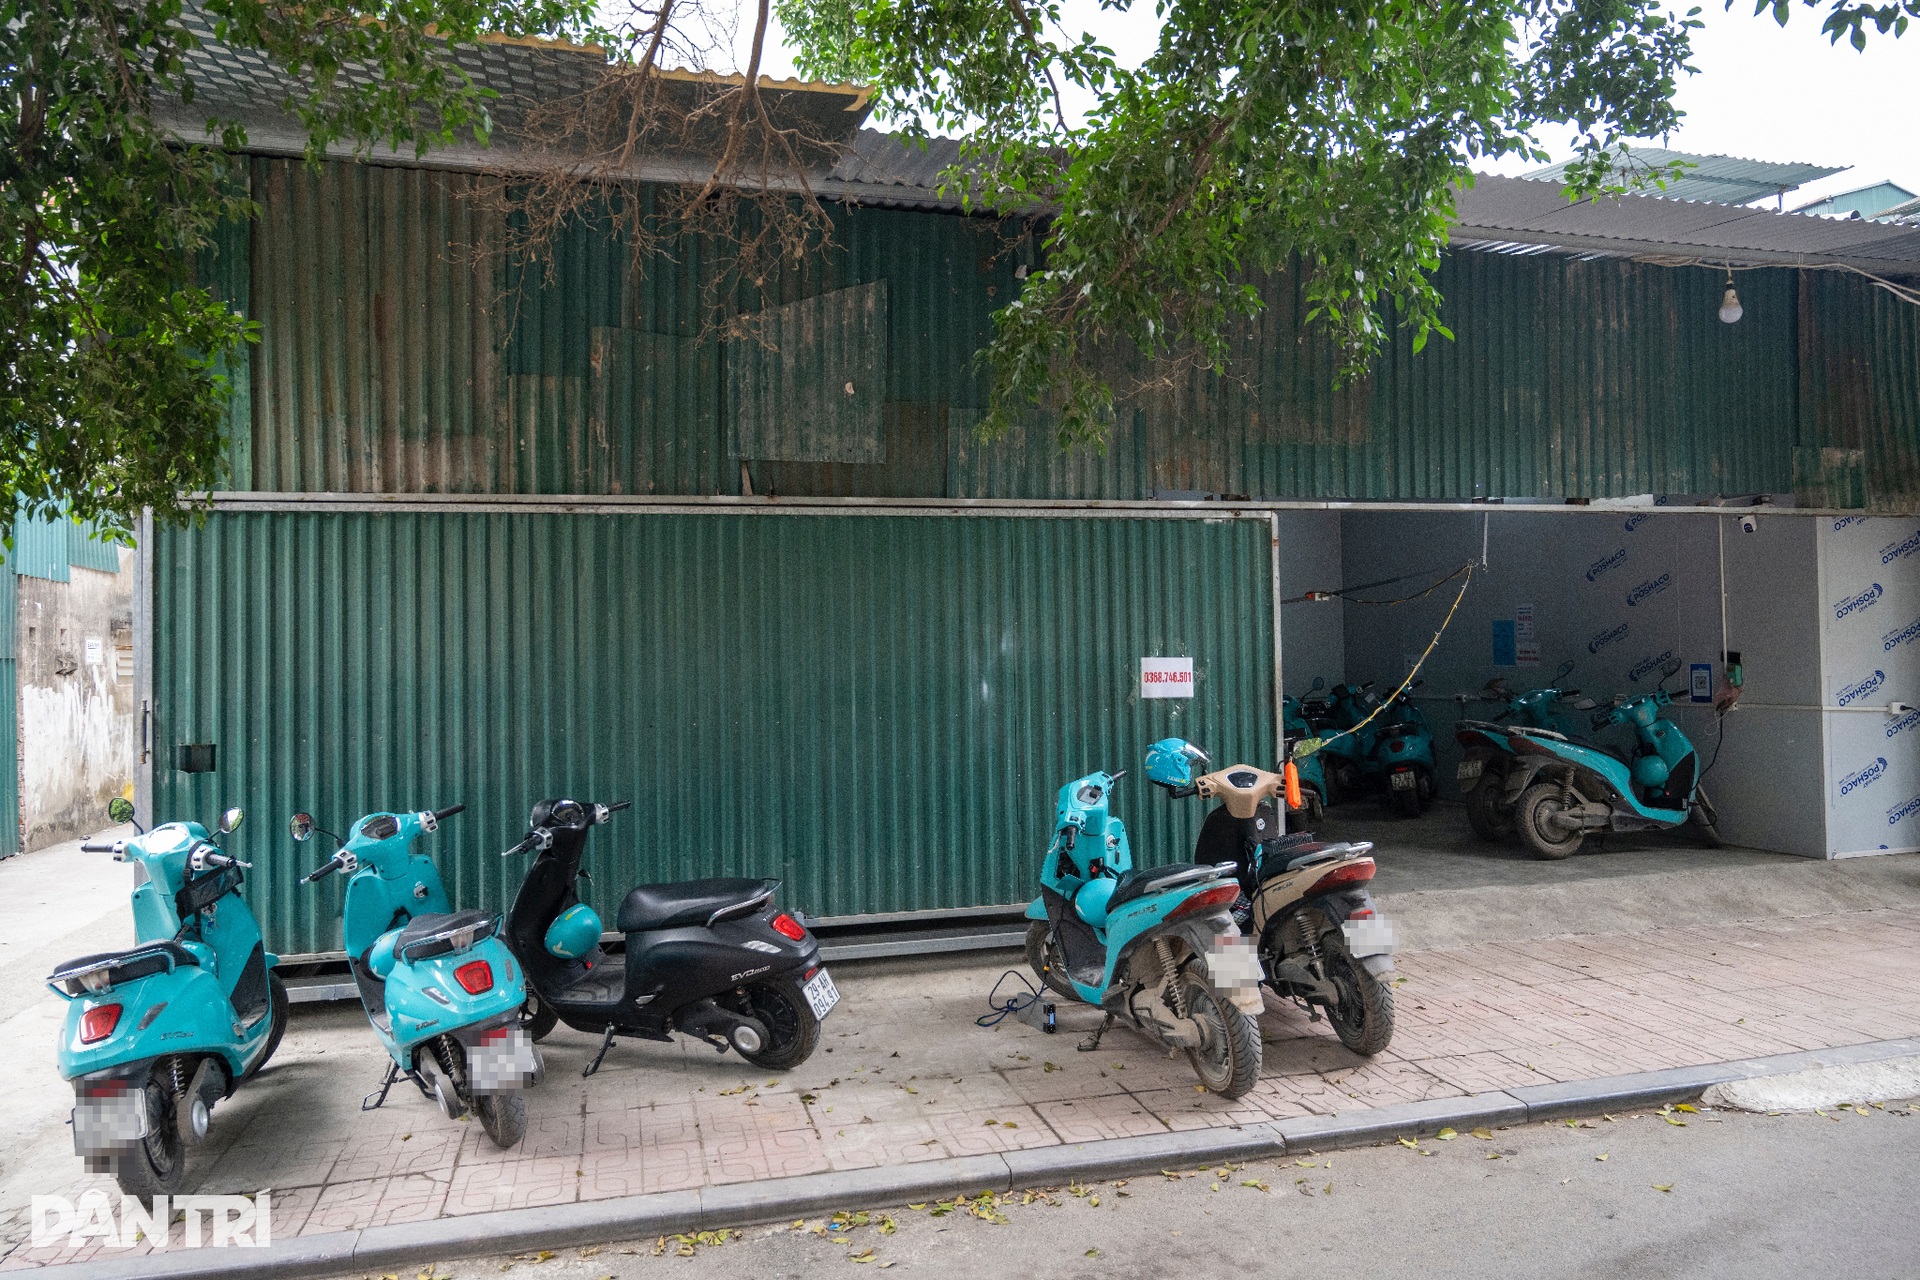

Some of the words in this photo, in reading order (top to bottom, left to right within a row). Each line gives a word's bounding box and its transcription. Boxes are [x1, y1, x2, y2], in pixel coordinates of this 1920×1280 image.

[1592, 549, 1626, 575] POSHACO
[1882, 536, 1920, 564] POSHACO
[1633, 573, 1669, 601] POSHACO
[1836, 589, 1876, 619] POSHACO
[1595, 623, 1628, 648] POSHACO
[1144, 671, 1192, 683] 0368.746.501
[1636, 651, 1672, 677] POSHACO
[1839, 676, 1878, 707] POSHACO
[1886, 711, 1920, 738] OSHACO
[1841, 764, 1880, 795] POSHACO
[1889, 798, 1920, 825] OSHACO
[813, 985, 839, 1017] 094.91
